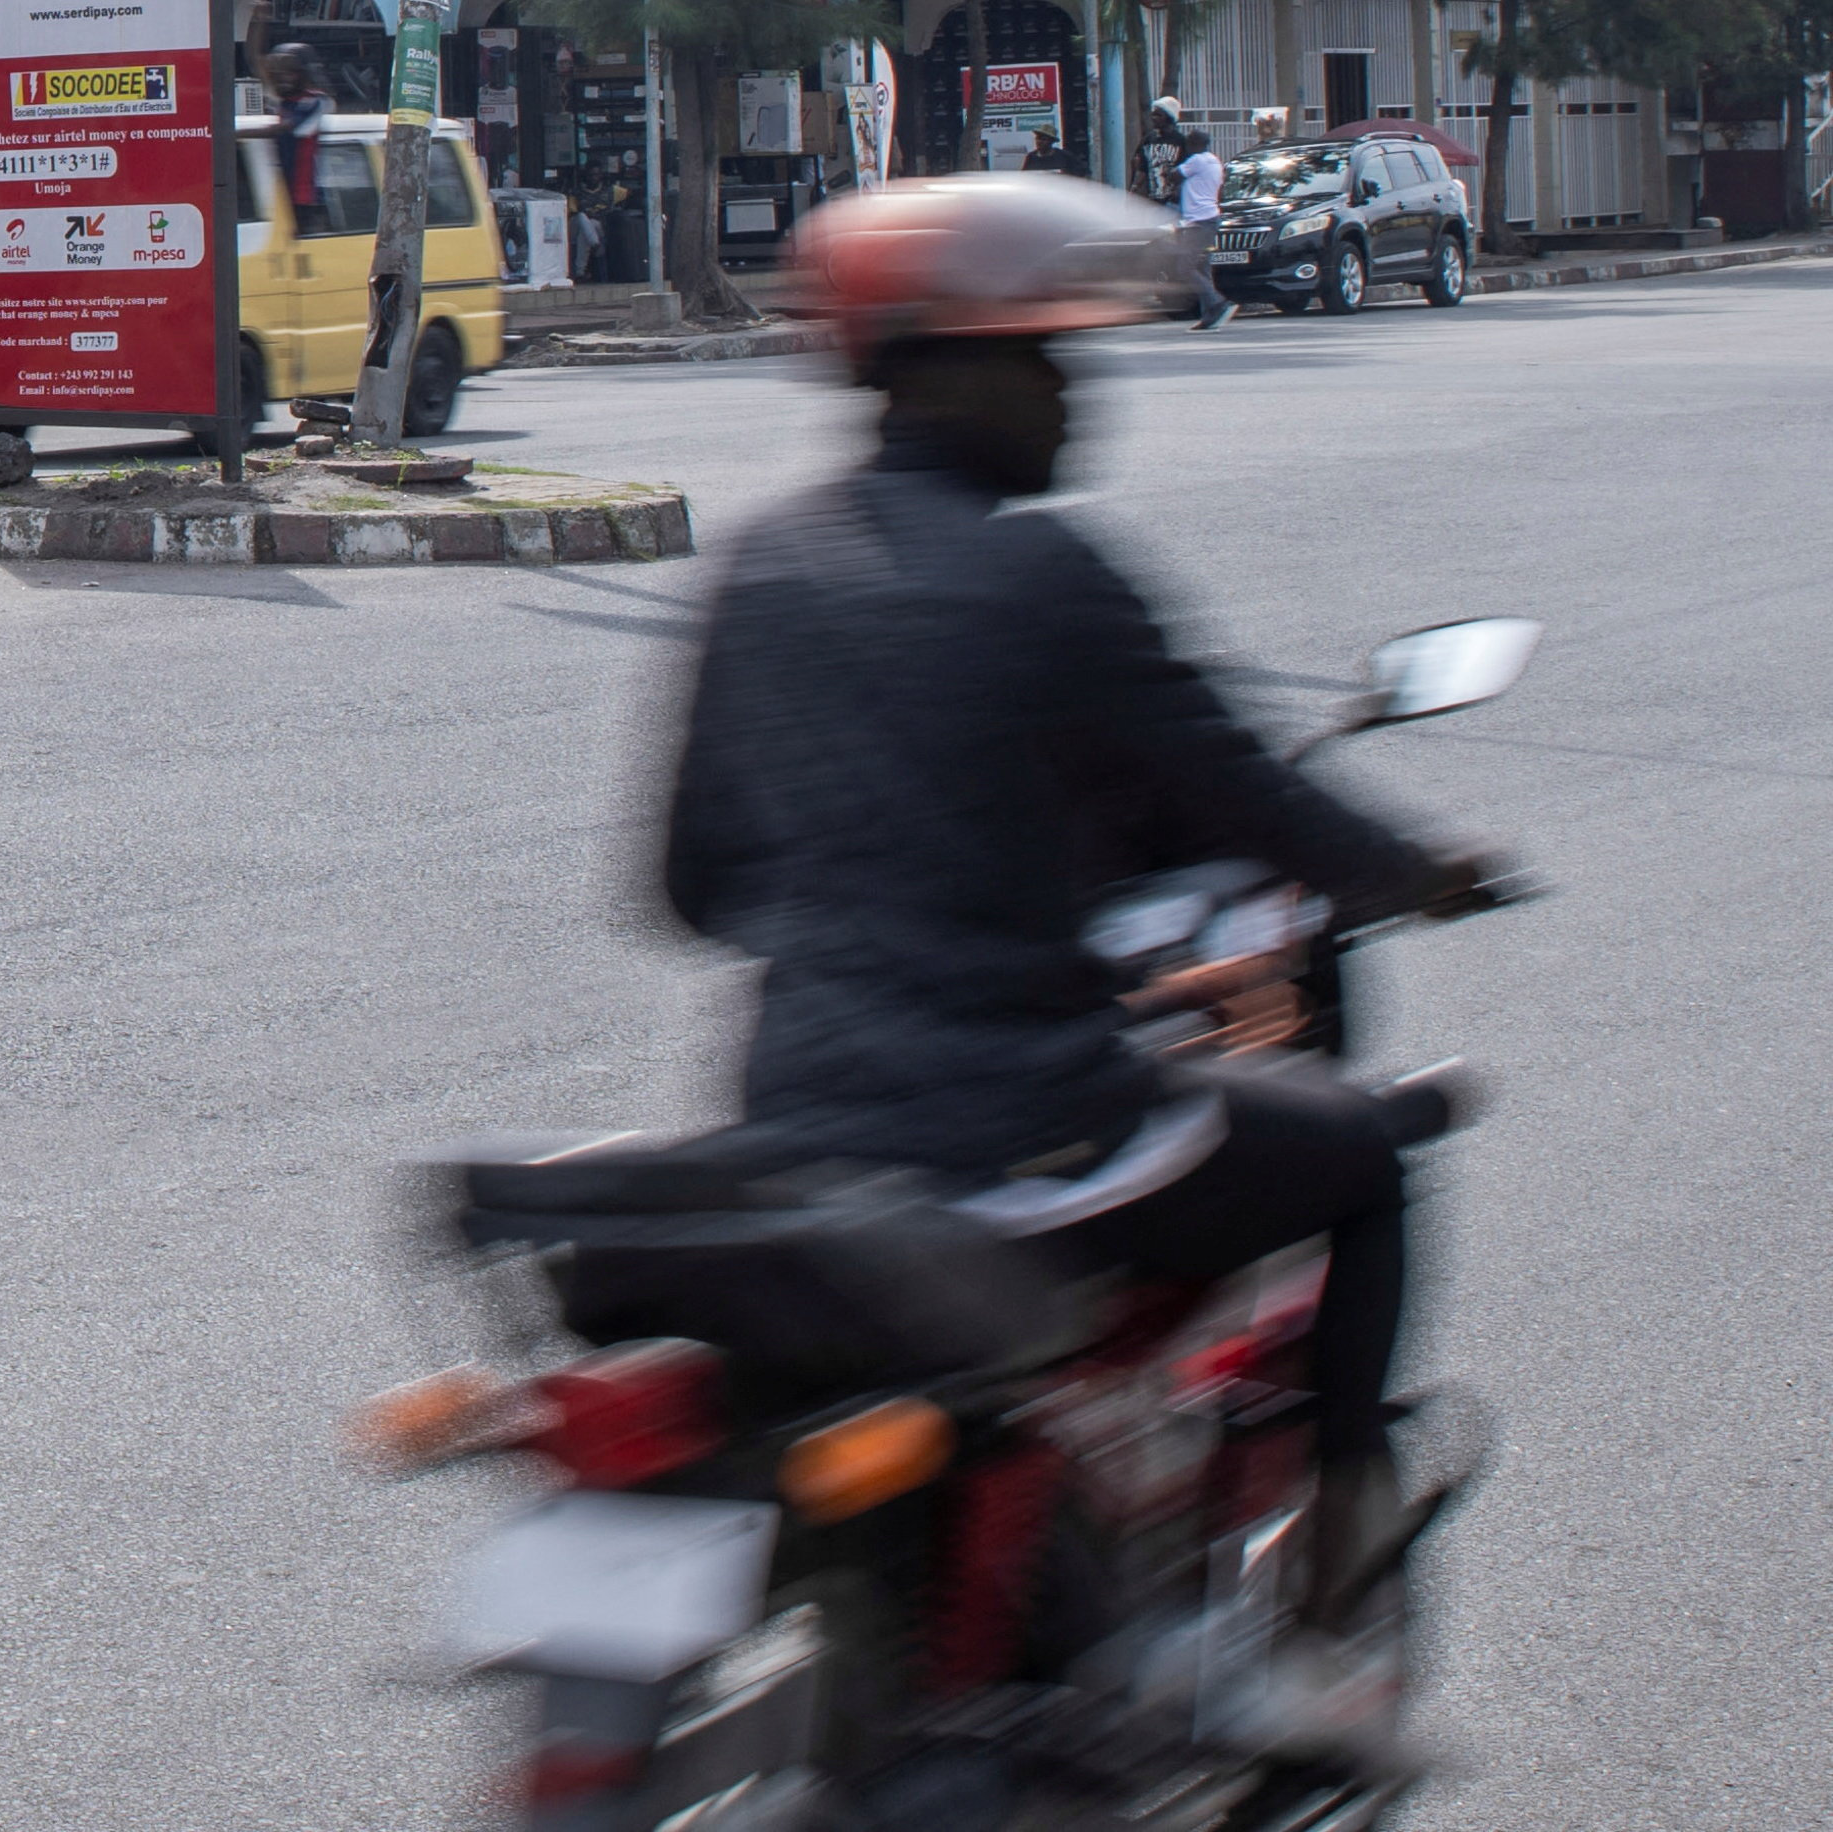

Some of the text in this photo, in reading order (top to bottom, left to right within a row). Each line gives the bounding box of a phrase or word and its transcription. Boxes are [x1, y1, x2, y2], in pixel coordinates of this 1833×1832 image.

[30, 5, 143, 21] www.serdipay.com
[49, 72, 142, 98] SOCODEE
[987, 72, 1045, 92] RBAN
[985, 89, 1045, 101] CHNOLOGY
[80, 104, 113, 115] Distribution
[32, 133, 50, 144] sur
[54, 129, 86, 142] airtel
[89, 130, 126, 144] money
[130, 130, 144, 140] en
[35, 182, 71, 196] Umoja
[1, 245, 31, 258] airtel
[66, 241, 105, 254] Orange
[66, 254, 103, 266] Money
[133, 248, 185, 264] m-pesa
[22, 298, 45, 307] notre
[48, 297, 63, 306] site
[65, 296, 145, 308] www.serdipay.com
[147, 296, 168, 307] pour
[17, 311, 48, 320] orange
[50, 310, 78, 320] money
[81, 309, 89, 317] &
[92, 309, 119, 319] mpesa
[18, 336, 62, 346] marchand
[76, 336, 115, 348] 377377
[18, 370, 52, 380] Contact
[60, 370, 81, 380] +243
[83, 370, 98, 379] 992
[100, 370, 114, 379] 291
[118, 369, 133, 379] 143
[19, 386, 45, 395] Email
[52, 385, 134, 397] info@serdipay.com
